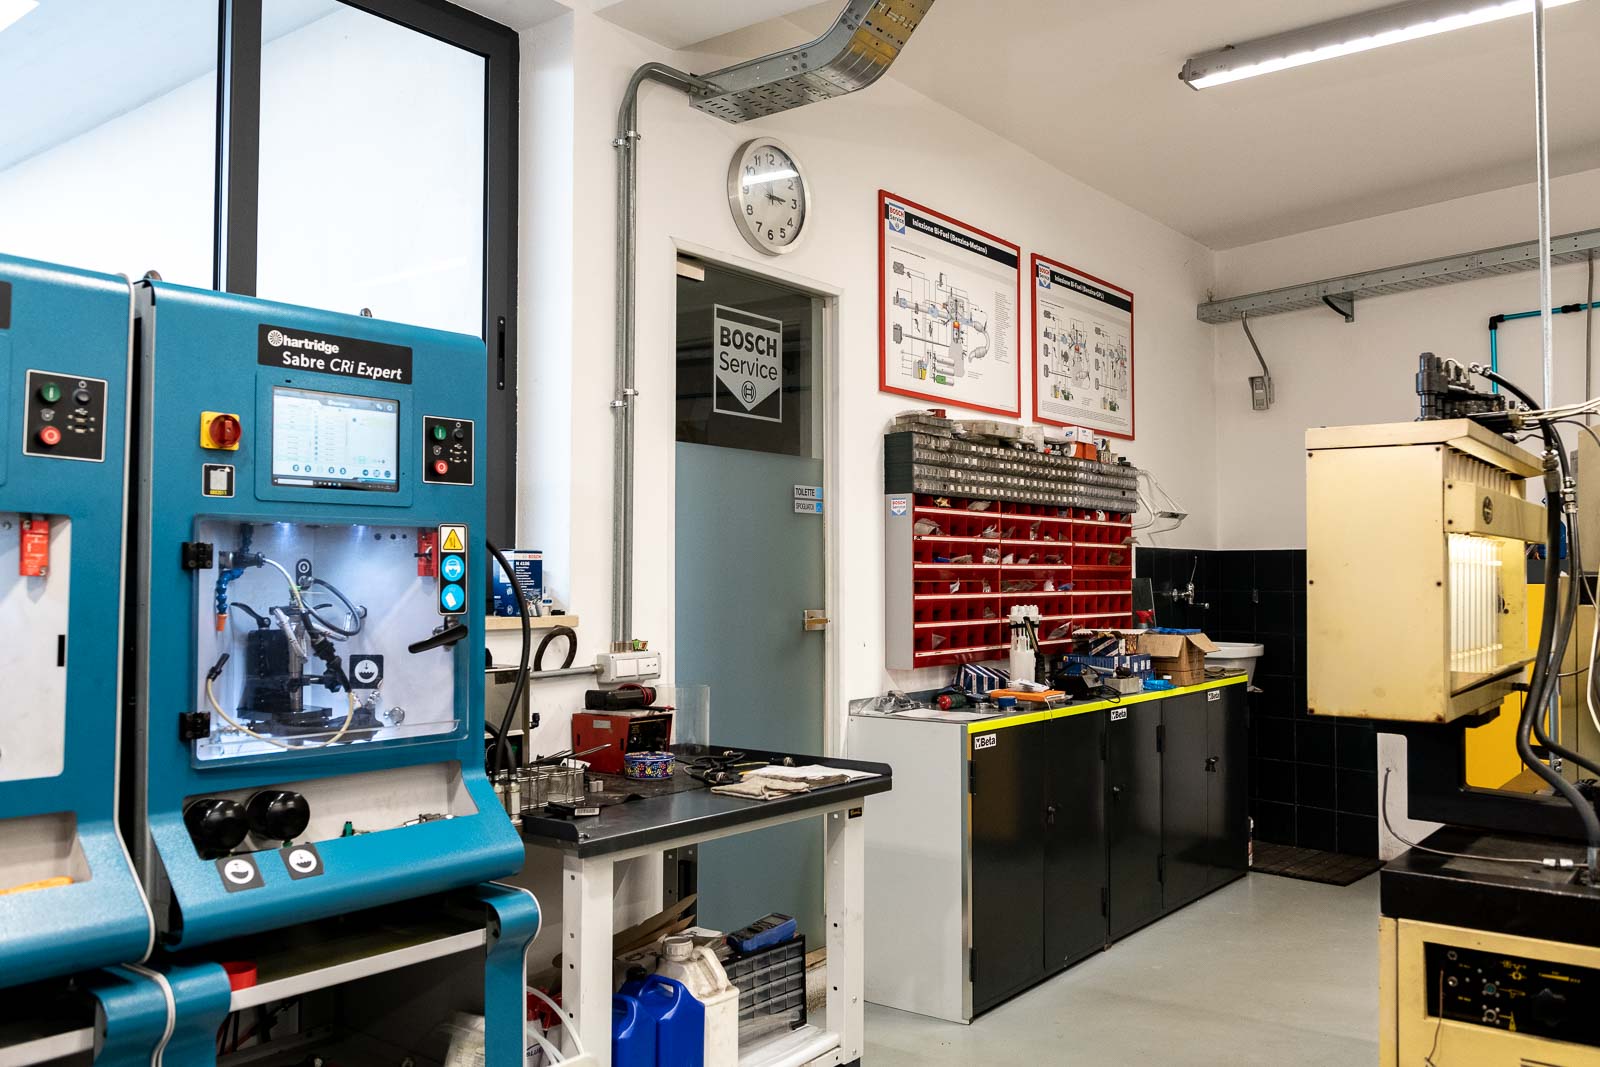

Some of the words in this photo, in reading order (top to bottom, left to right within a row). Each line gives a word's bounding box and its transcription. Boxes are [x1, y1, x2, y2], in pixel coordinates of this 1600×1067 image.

[754, 155, 761, 166] 11
[765, 153, 775, 166] 12
[745, 165, 756, 175] 10
[742, 185, 750, 195] 9
[787, 180, 794, 190] 2
[746, 204, 754, 216] 8
[791, 199, 797, 210] 3
[890, 206, 904, 218] BOSCH
[787, 217, 794, 228] 4
[889, 214, 905, 225] Service
[755, 221, 763, 233] 7
[767, 229, 774, 241] 6
[779, 228, 786, 239] 5
[282, 334, 340, 355] hartridge
[719, 325, 777, 358] BOSCH
[282, 351, 325, 370] Sabre
[330, 358, 354, 374] CRi
[357, 362, 402, 380] Expert
[719, 351, 778, 381] Service
[795, 487, 815, 496] TOILETTE
[980, 736, 996, 747] Beta
